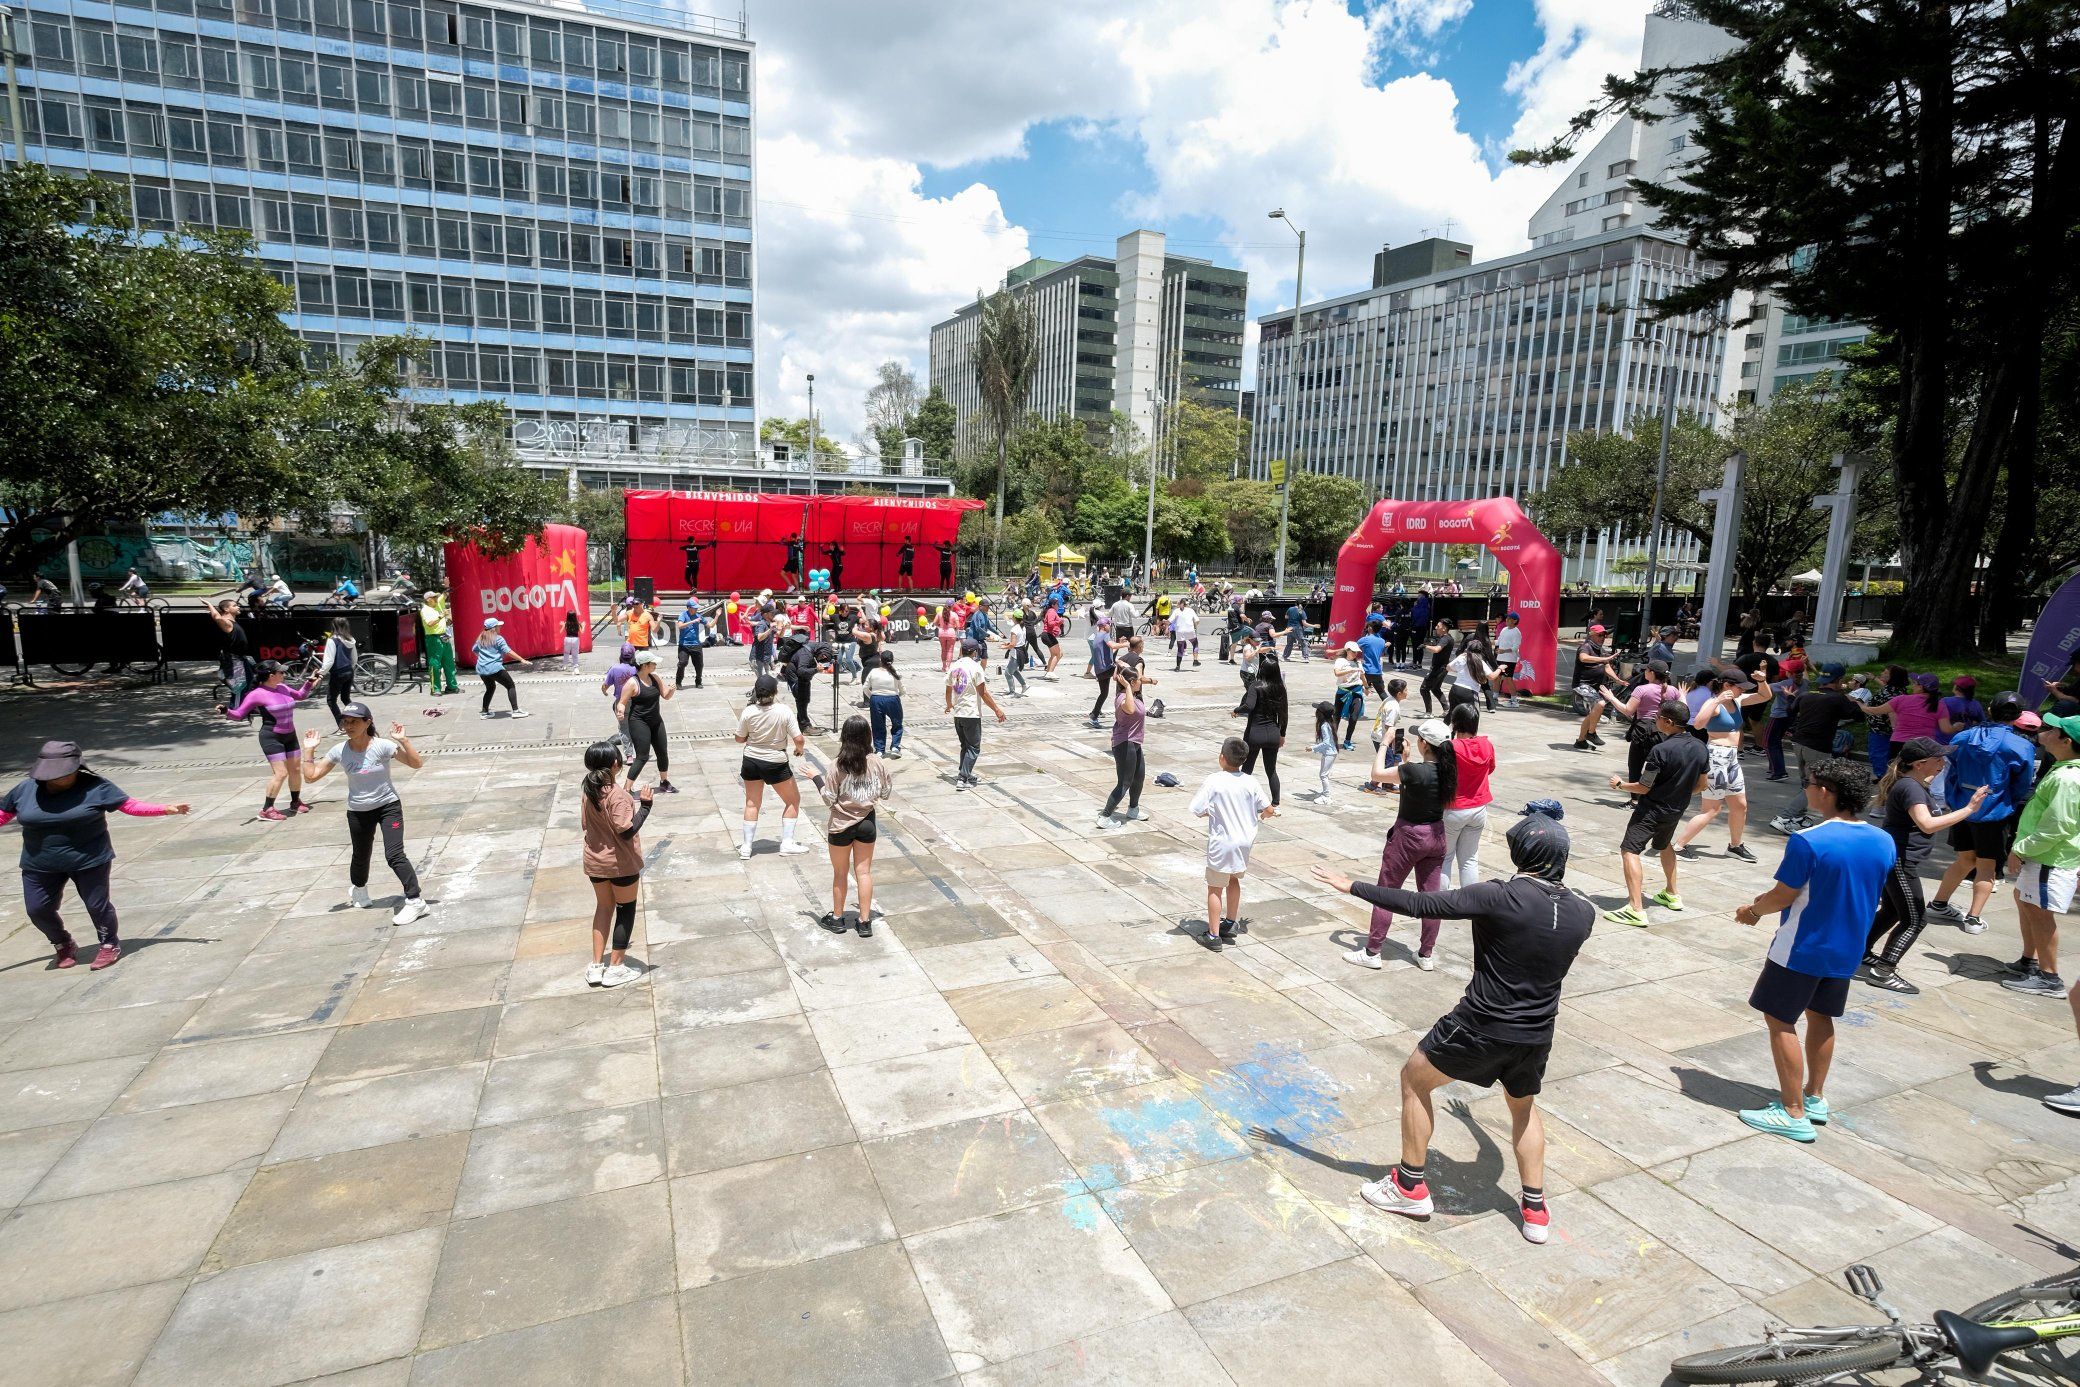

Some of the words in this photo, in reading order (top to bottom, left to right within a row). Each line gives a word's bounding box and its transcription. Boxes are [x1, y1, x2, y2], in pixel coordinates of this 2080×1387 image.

[686, 491, 759, 503] BIENVENIDOS
[874, 498, 937, 509] BIENVENIDOS
[1406, 517, 1427, 530] IDRD
[1340, 585, 1355, 593] IDRD
[1520, 600, 1541, 609] IDRD
